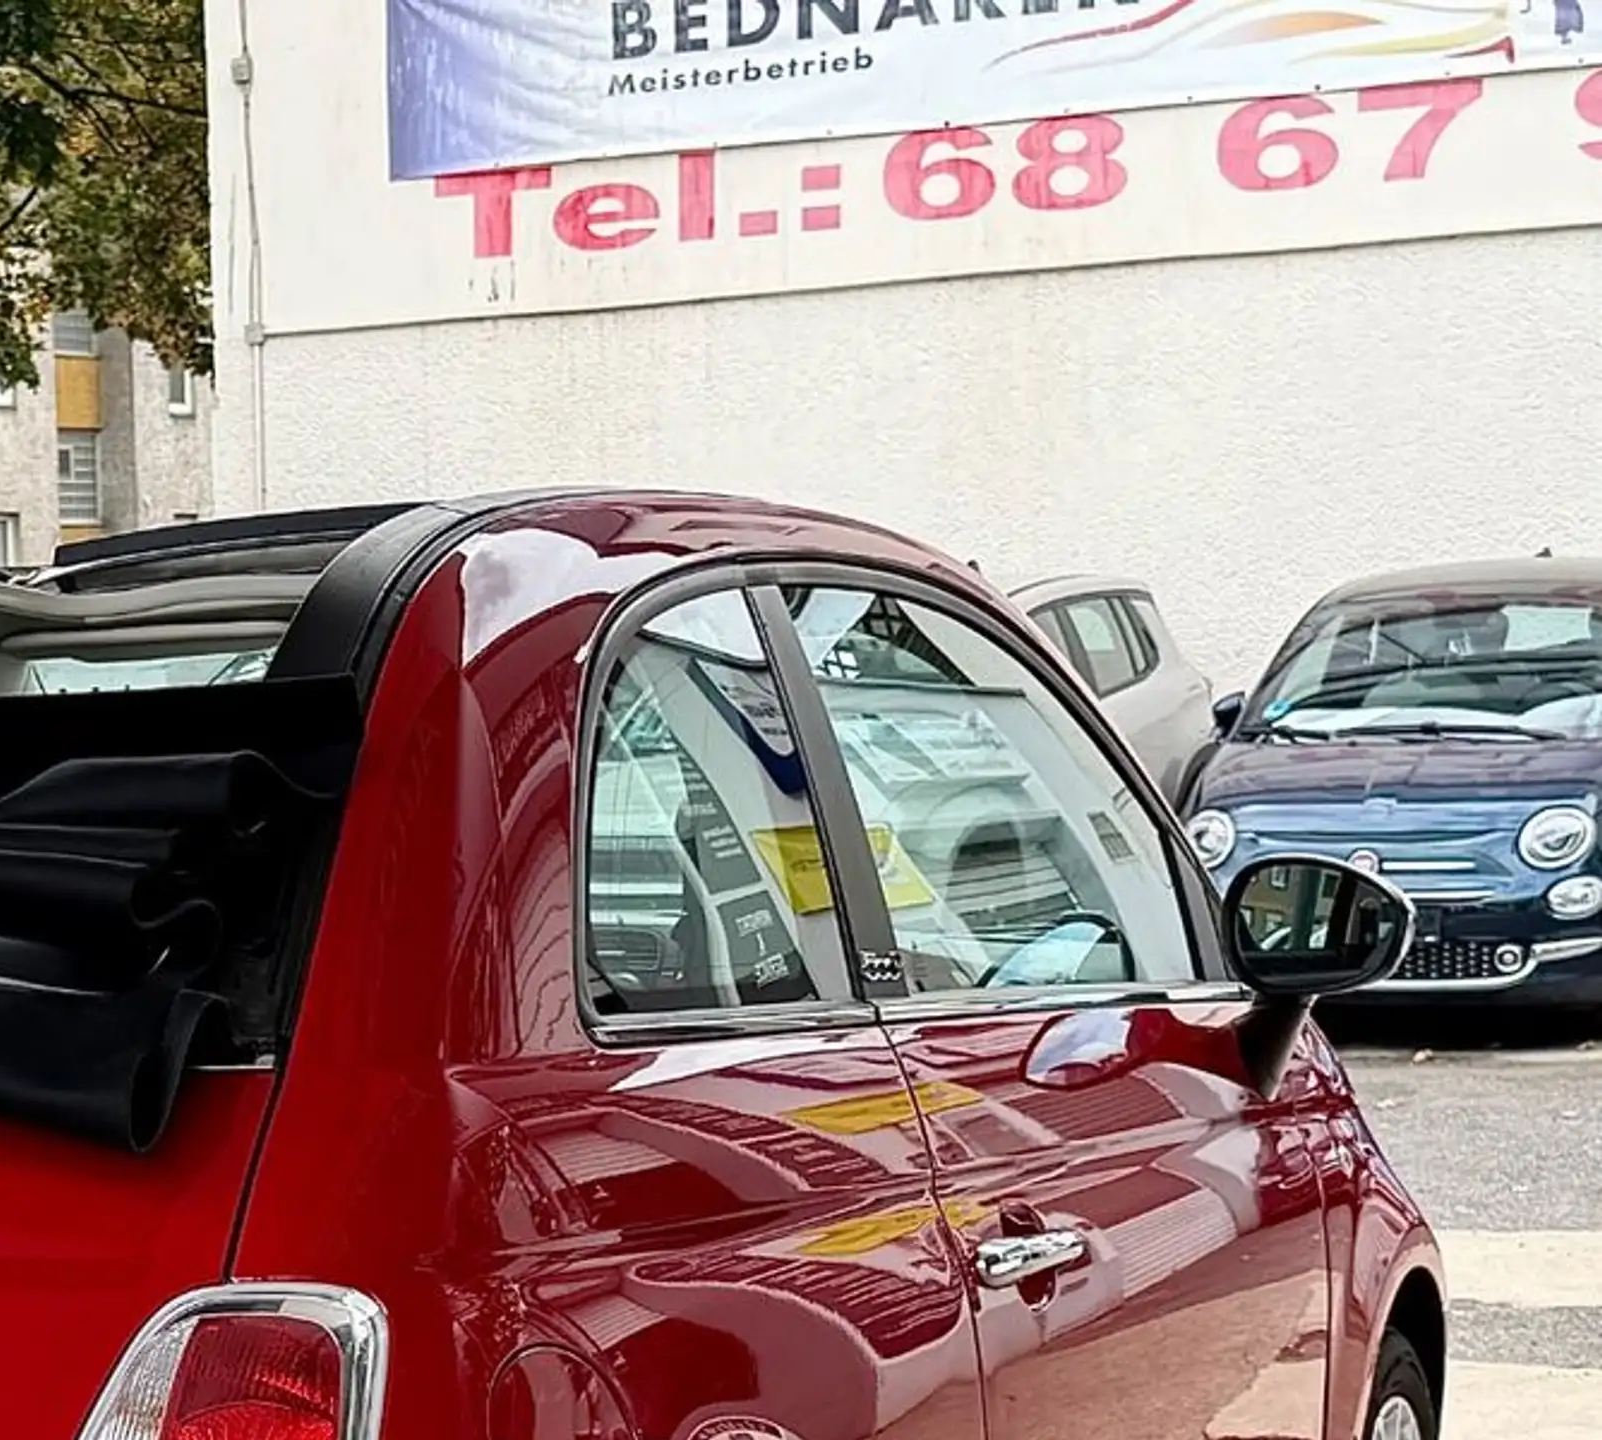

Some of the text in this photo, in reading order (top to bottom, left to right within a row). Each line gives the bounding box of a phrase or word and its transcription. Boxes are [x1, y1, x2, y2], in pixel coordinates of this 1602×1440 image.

[607, 46, 874, 96] Meisterbetrieb
[434, 148, 842, 258] Tel.:
[883, 113, 1129, 221] 68
[1216, 77, 1484, 192] 67
